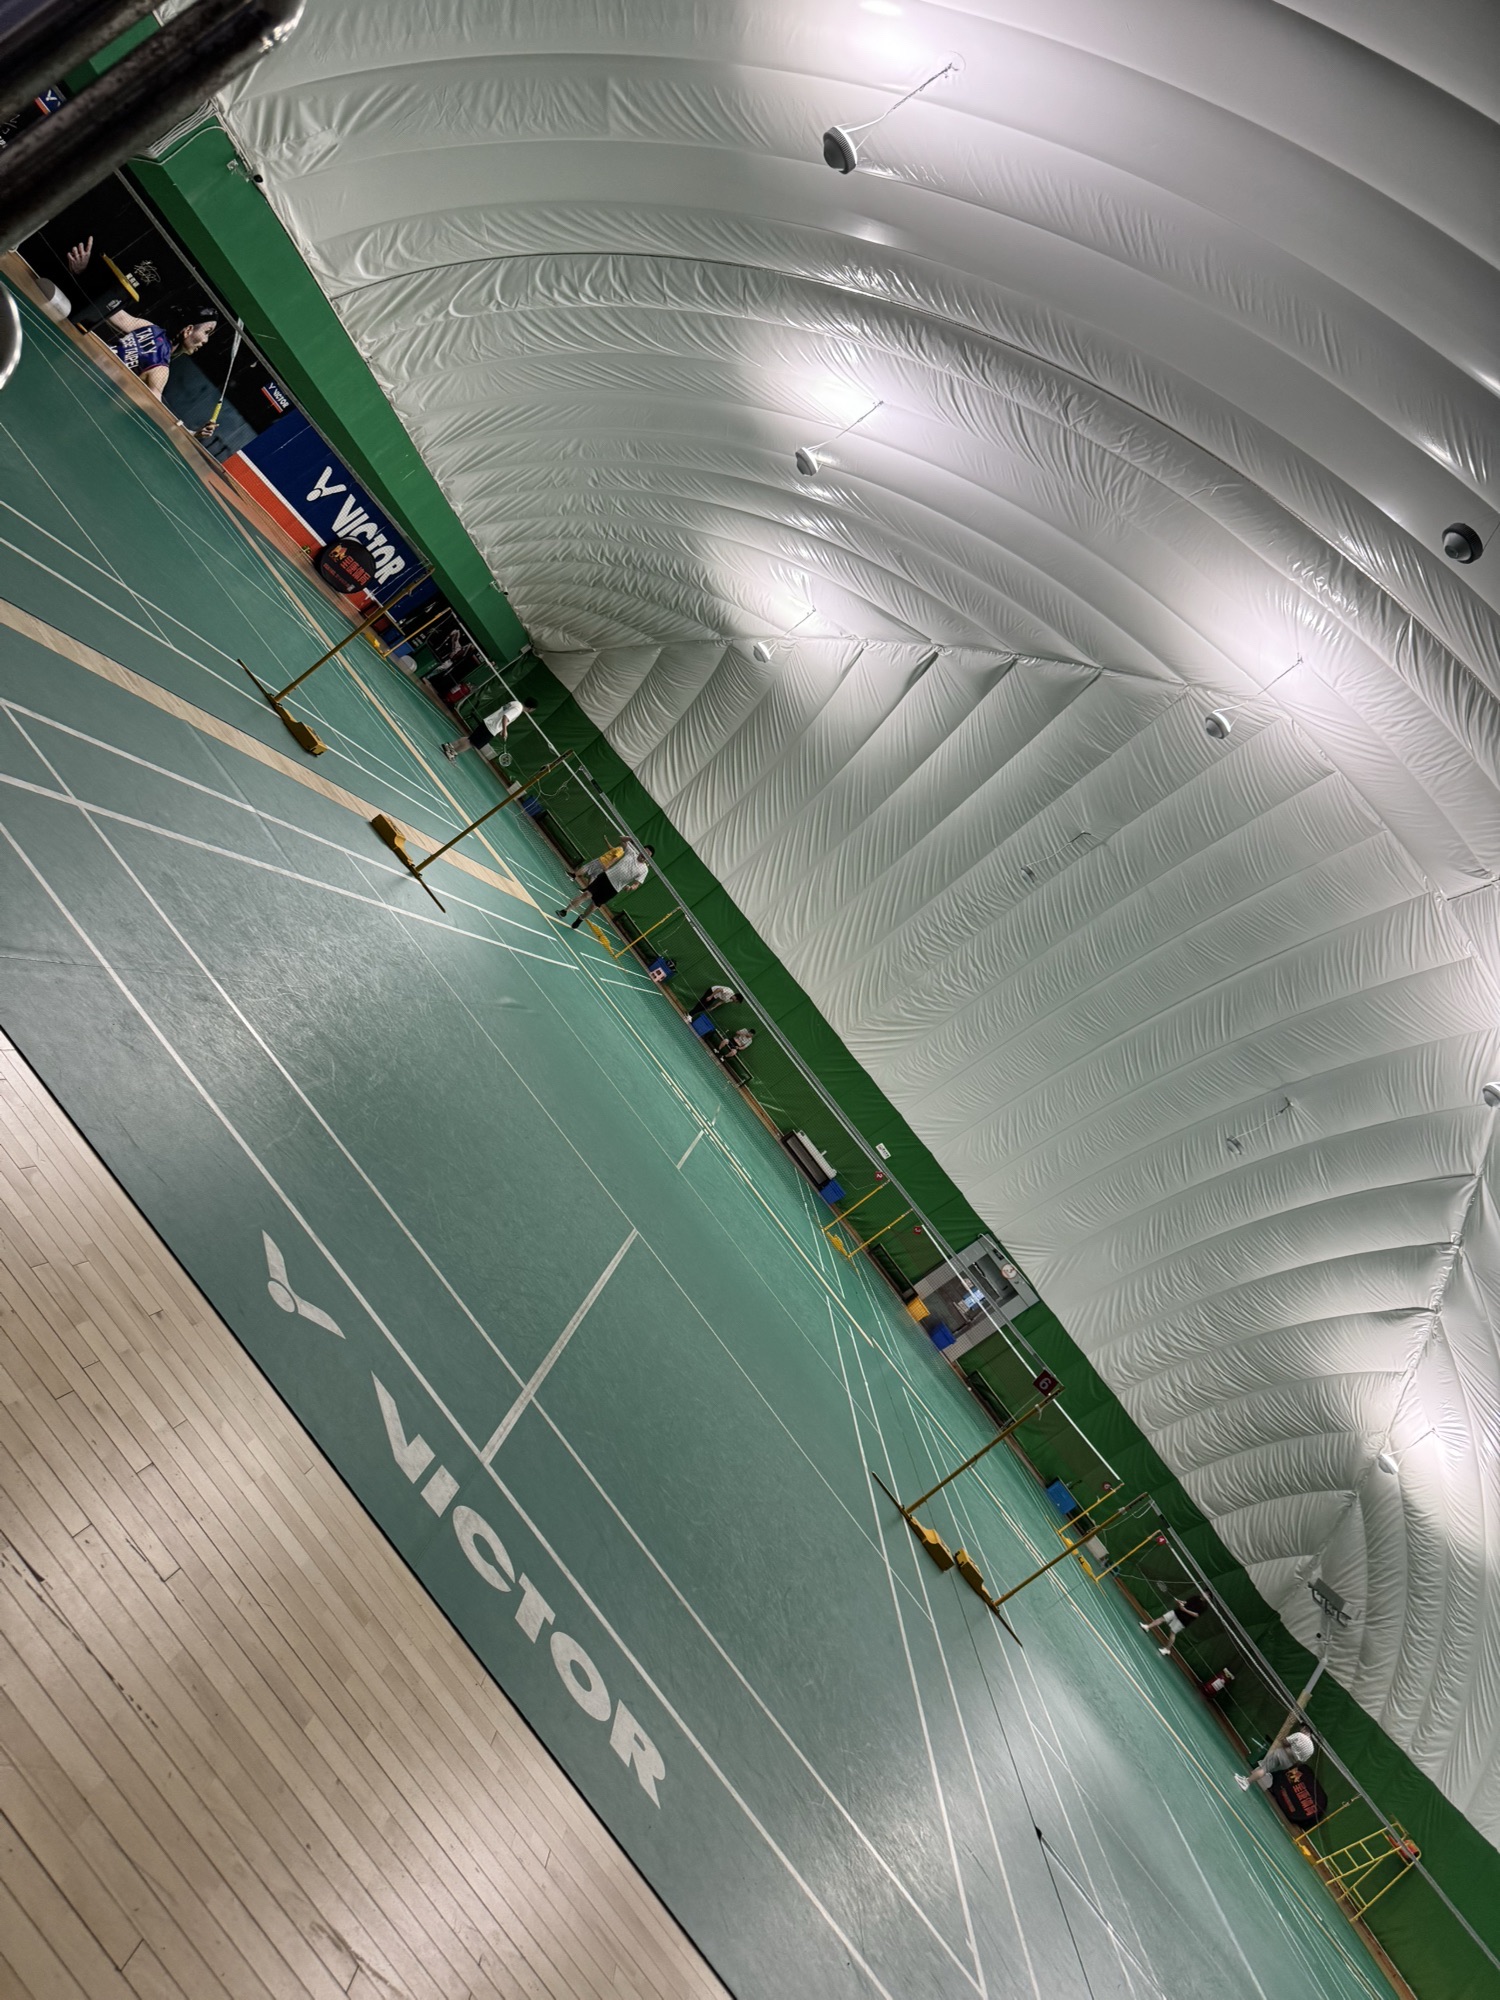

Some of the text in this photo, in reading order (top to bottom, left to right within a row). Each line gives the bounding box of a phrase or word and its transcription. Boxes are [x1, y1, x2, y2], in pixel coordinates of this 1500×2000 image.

[273, 388, 290, 409] VICTOR
[331, 493, 406, 585] VICTOR
[1039, 1377, 1052, 1390] 6
[371, 1371, 666, 1810] VICTOR
